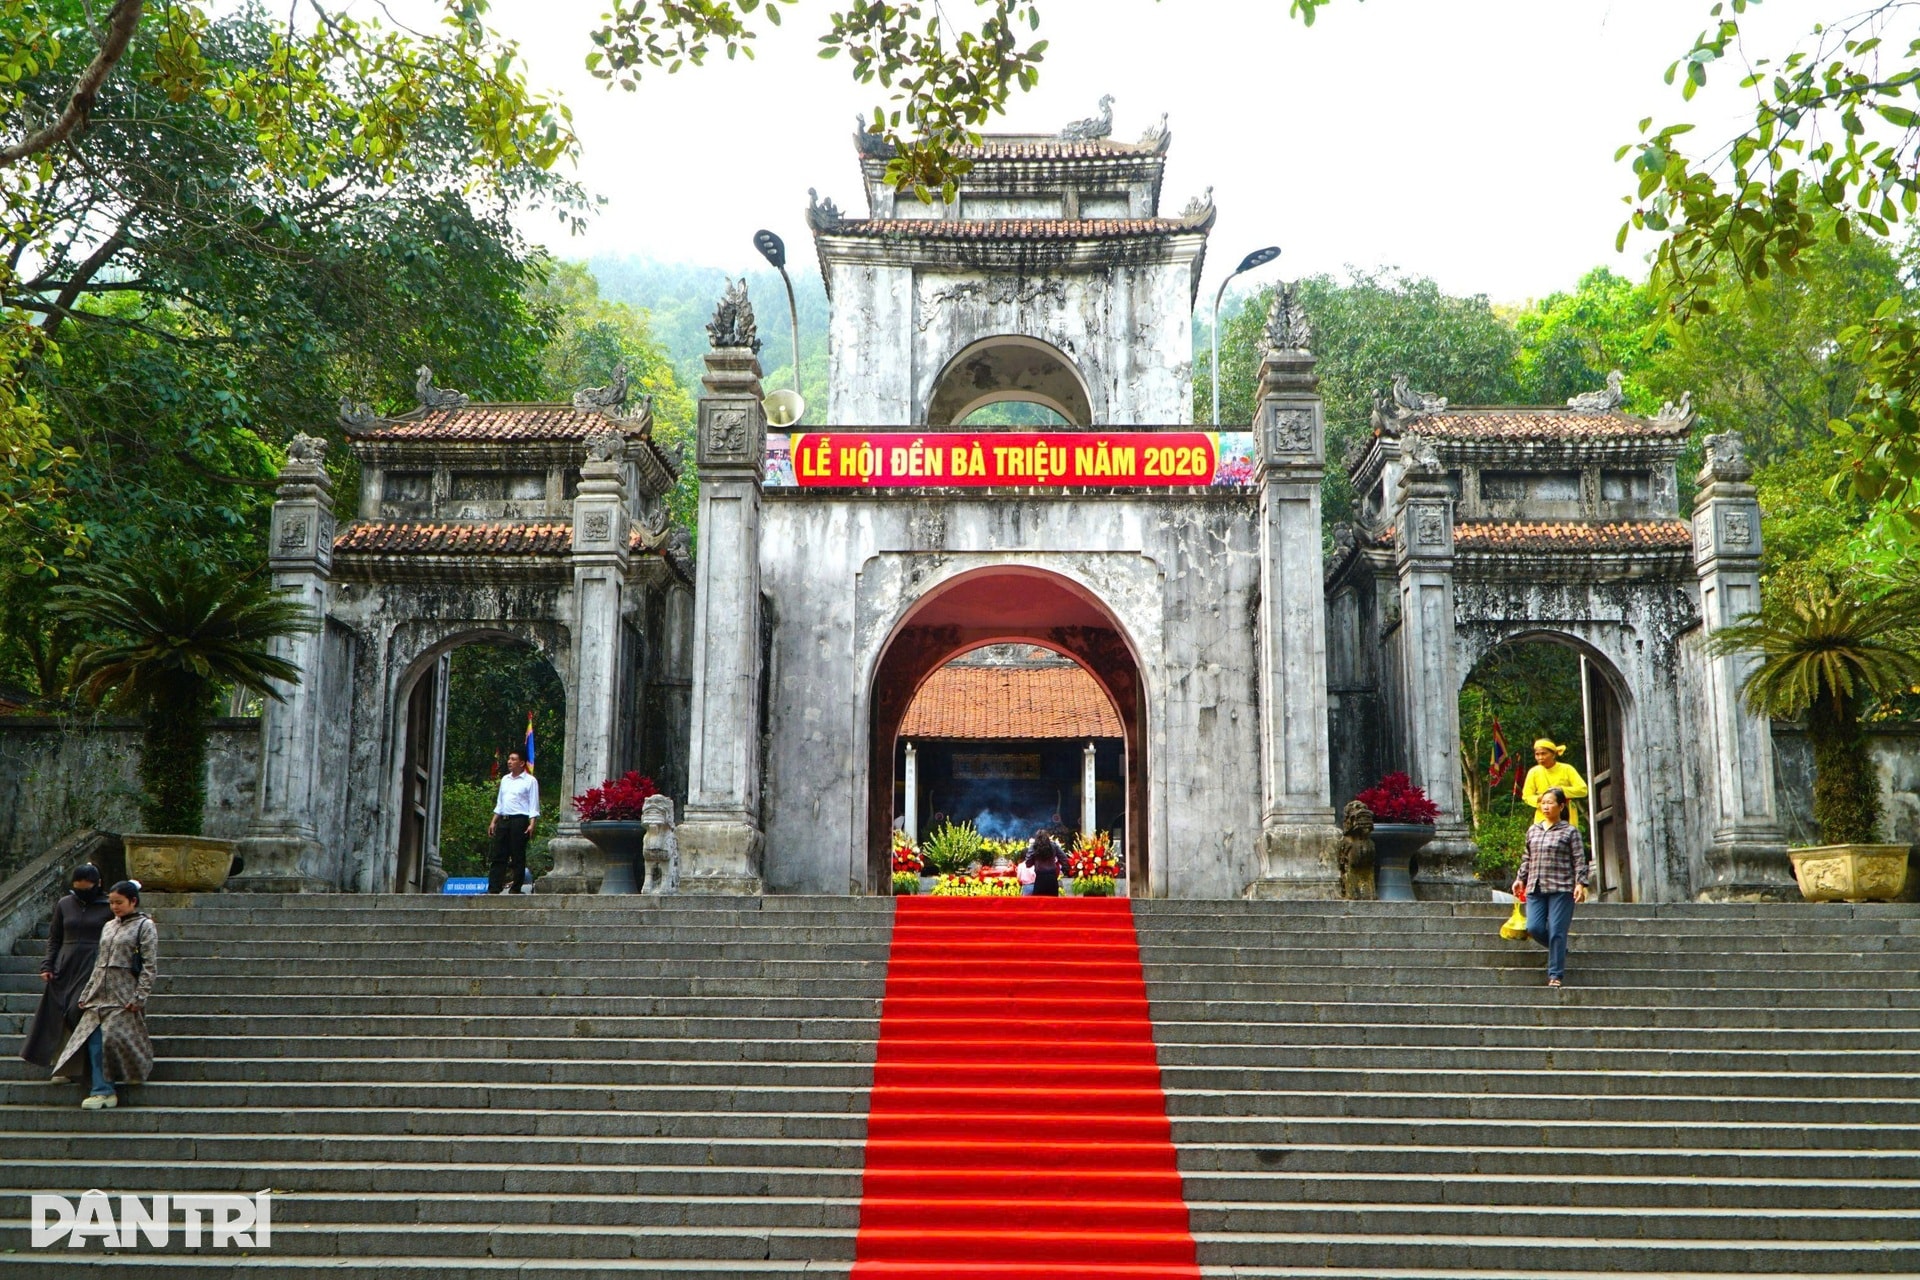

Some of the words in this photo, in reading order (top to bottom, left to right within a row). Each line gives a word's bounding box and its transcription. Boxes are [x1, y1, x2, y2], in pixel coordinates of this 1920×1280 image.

[803, 437, 831, 476] LỄ
[840, 442, 882, 482] HỘI
[890, 438, 942, 476] ĐỀN
[951, 441, 986, 476] BÀ
[993, 441, 1067, 482] TRIỆU
[1075, 441, 1136, 476] NĂM
[1144, 447, 1207, 476] 2026
